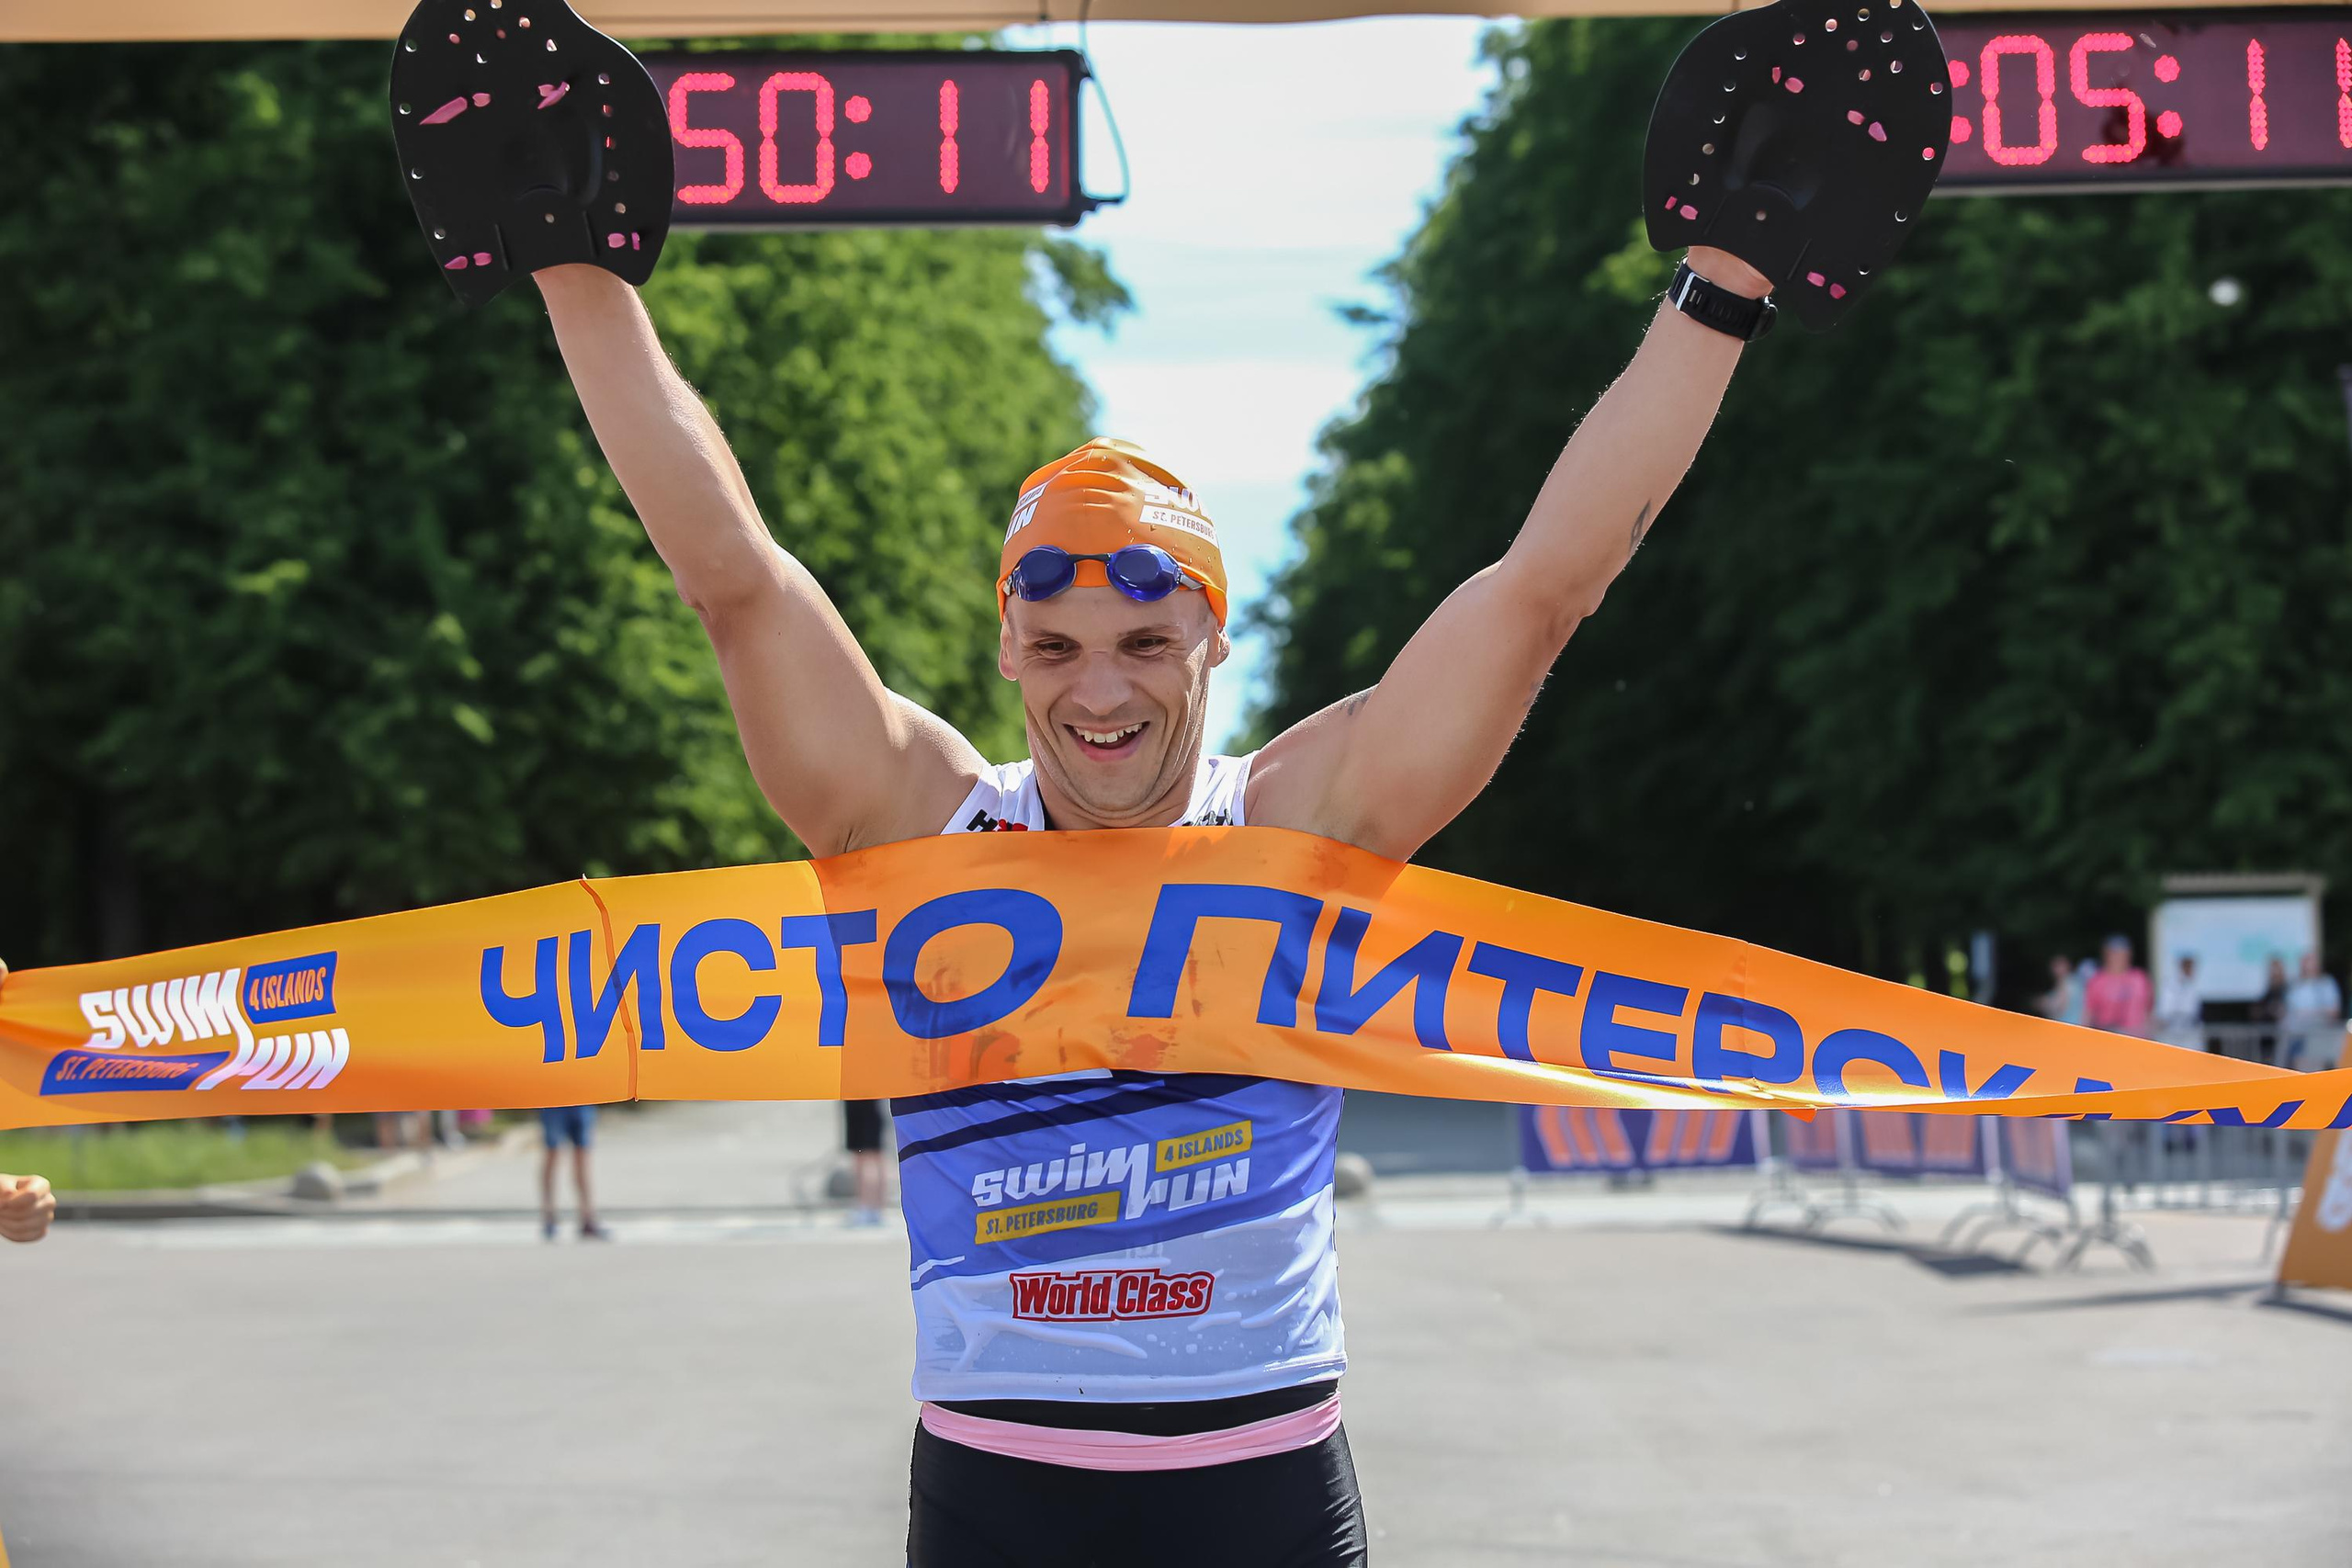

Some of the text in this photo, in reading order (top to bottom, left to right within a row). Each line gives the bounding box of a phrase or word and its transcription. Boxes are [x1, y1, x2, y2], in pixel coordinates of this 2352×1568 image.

[669, 73, 1049, 204] 50:11
[249, 966, 326, 1010] 4 ISLANDS
[480, 884, 2115, 1108] ЧИСТО ПИТЕРСК
[55, 1056, 77, 1081] ST.
[1164, 1129, 1245, 1162] 4 ISLANDS
[985, 1201, 1099, 1235] ST. PETERSBURG
[1017, 1275, 1209, 1315] World Class
